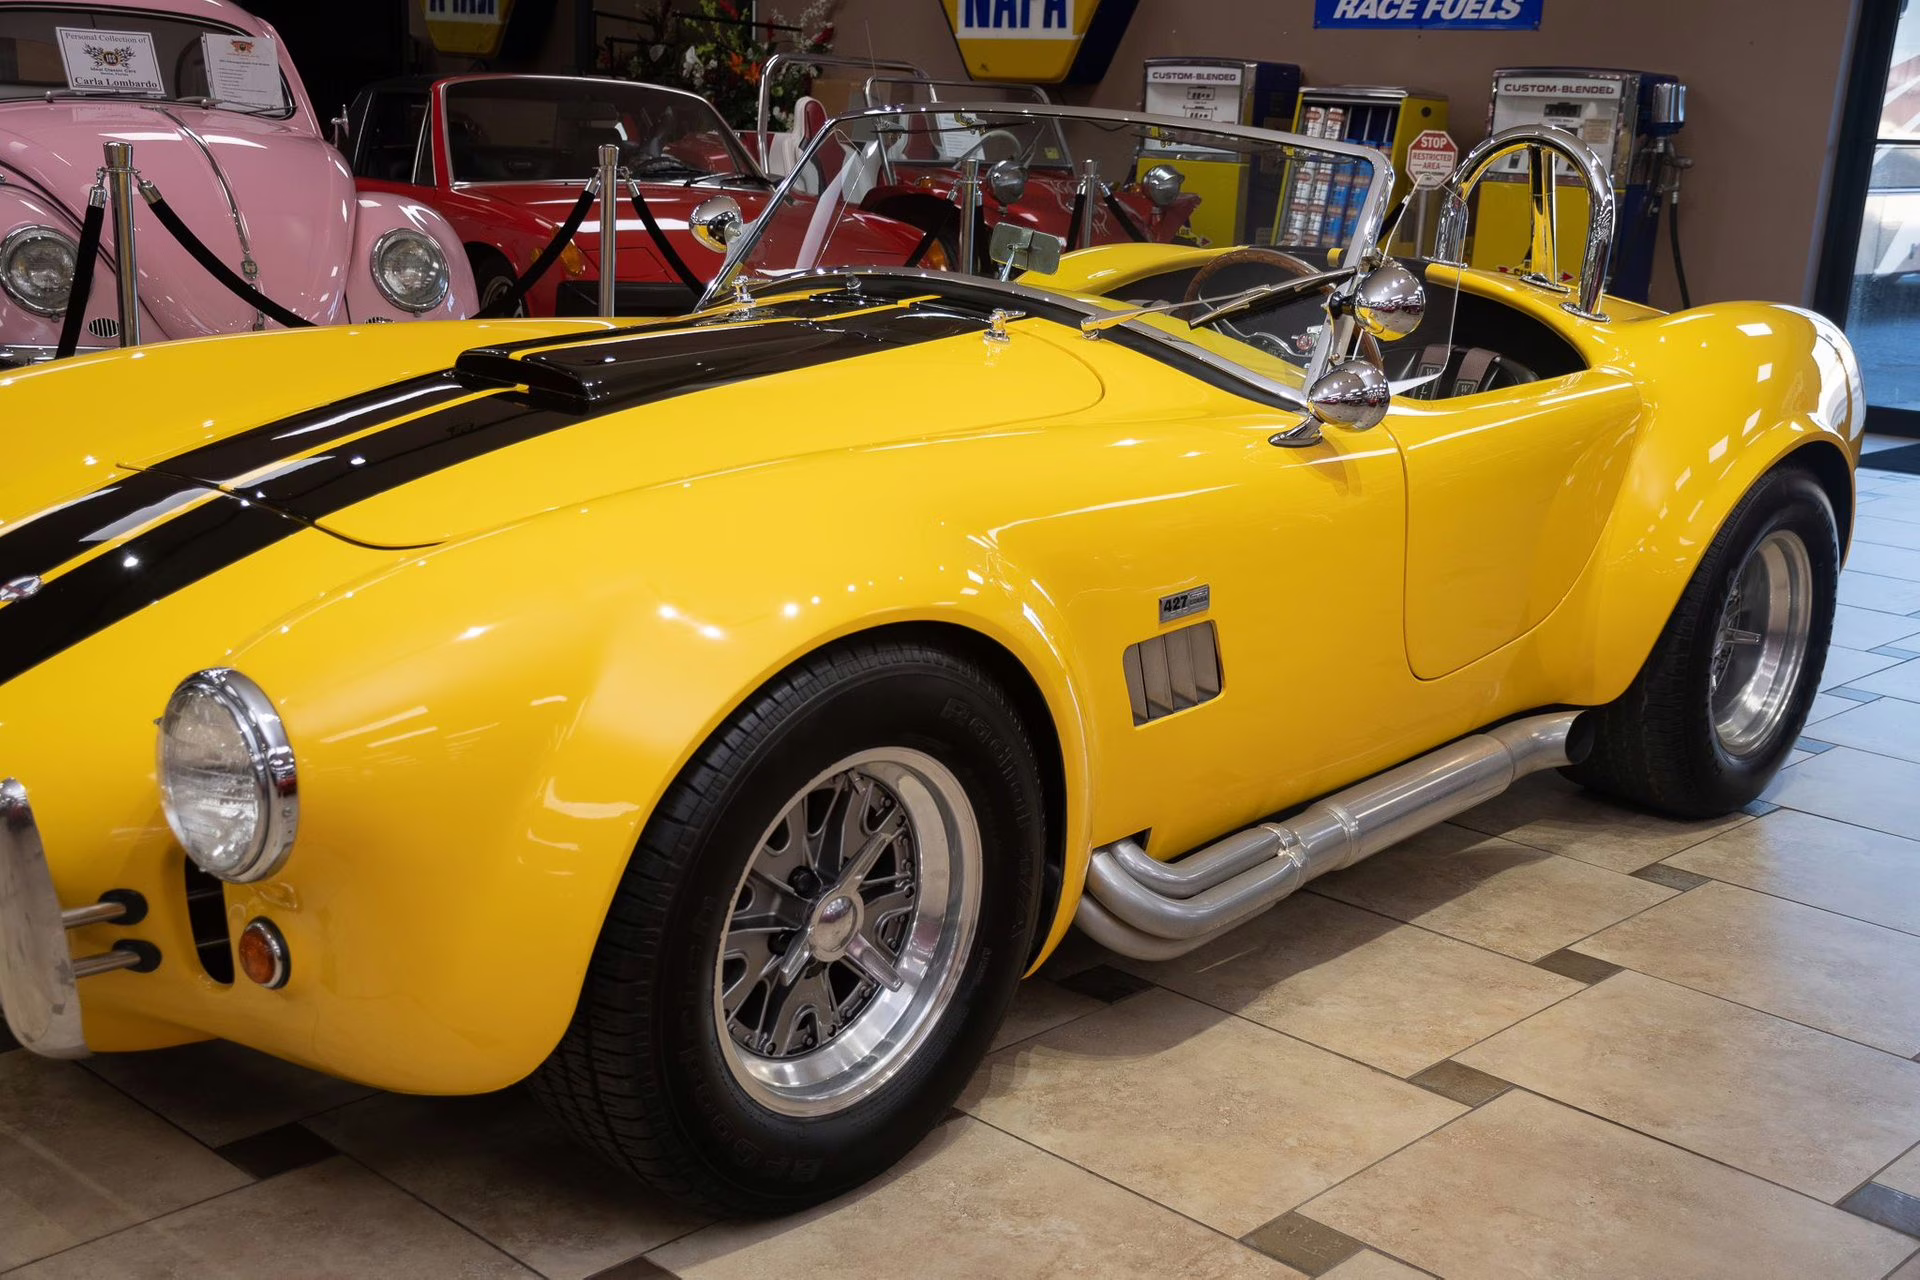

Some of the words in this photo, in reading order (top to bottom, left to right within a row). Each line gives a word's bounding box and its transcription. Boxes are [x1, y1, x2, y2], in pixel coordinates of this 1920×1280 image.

[1333, 0, 1420, 20] RACE
[1421, 0, 1525, 20] FUELS
[65, 32, 97, 41] Personal
[98, 35, 138, 44] Collection
[75, 76, 103, 86] Carla
[106, 78, 158, 88] Lombardo
[1152, 72, 1236, 81] CUSTOM-BLENDED
[1504, 84, 1615, 94] CUSTOM-BLENDED
[1421, 136, 1447, 148] STOP
[1412, 153, 1452, 161] RESTRICTED
[1422, 161, 1441, 169] AREA
[1163, 594, 1189, 612] 427
